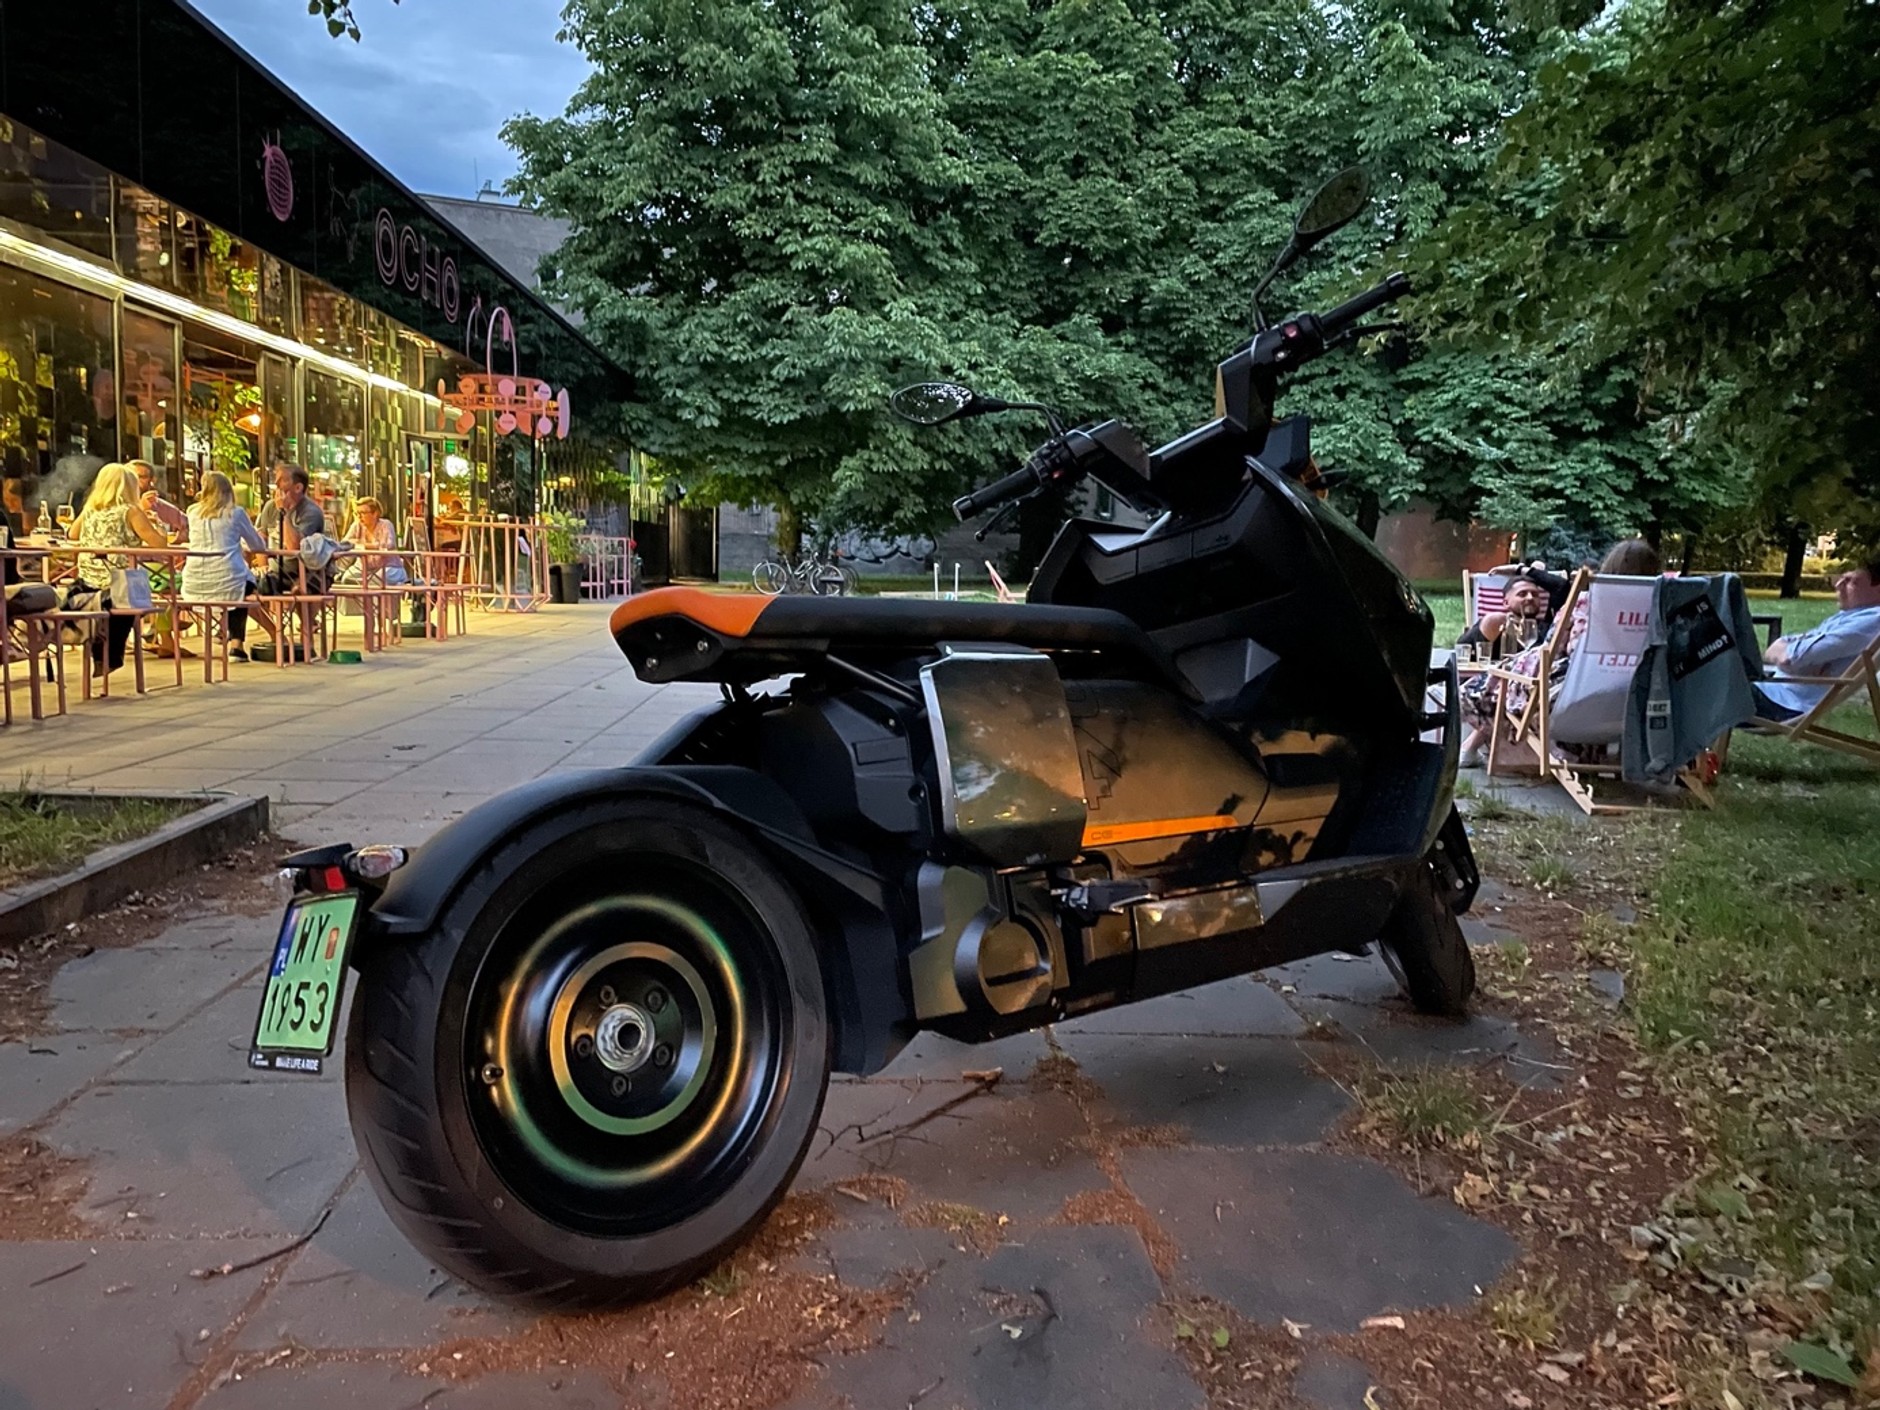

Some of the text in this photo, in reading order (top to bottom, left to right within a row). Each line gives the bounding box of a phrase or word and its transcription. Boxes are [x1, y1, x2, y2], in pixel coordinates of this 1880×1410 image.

[375, 207, 460, 323] OCHO
[1696, 601, 1709, 614] IS
[1697, 634, 1729, 660] MIND?
[295, 914, 330, 963] WY
[267, 982, 330, 1033] 1953
